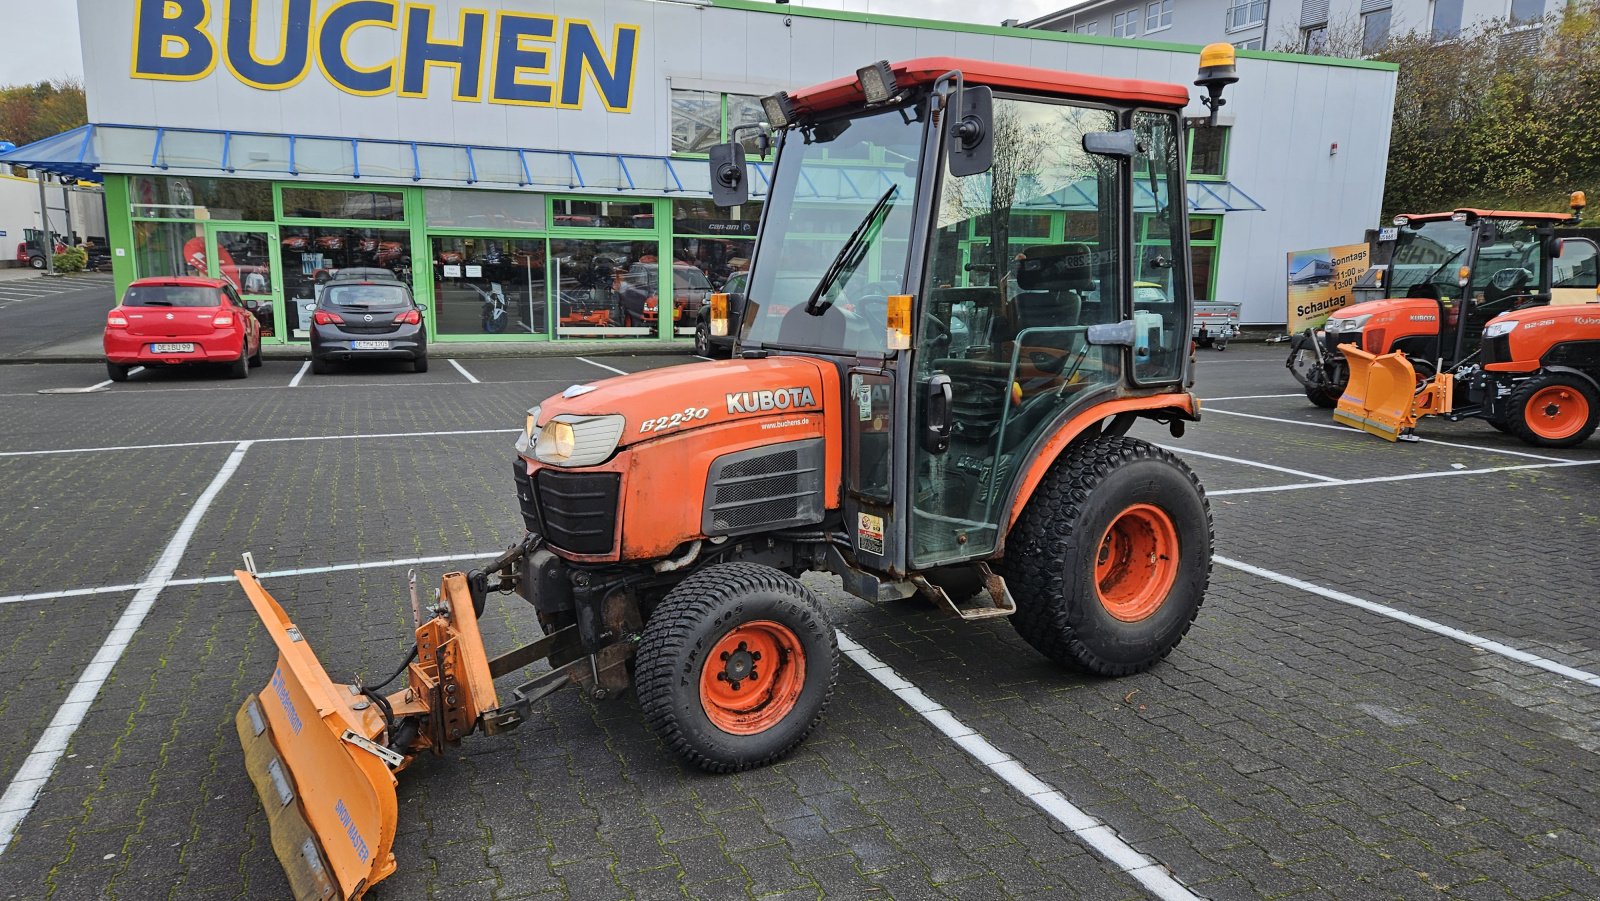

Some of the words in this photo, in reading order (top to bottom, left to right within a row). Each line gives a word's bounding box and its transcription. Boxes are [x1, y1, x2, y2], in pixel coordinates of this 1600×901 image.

[129, 0, 642, 114] BUCHEN
[1331, 250, 1367, 267] Sonntags
[1336, 267, 1356, 280] 11:00
[1333, 277, 1353, 291] 13:00
[1297, 295, 1346, 317] Schautag
[1409, 314, 1436, 322] KUBOTA
[182, 343, 191, 351] 99
[725, 386, 816, 415] KUBOTA
[639, 407, 710, 434] B2230
[761, 418, 809, 430] www.buchens.de
[335, 798, 352, 829] SNOW
[347, 822, 370, 865] MASTER
